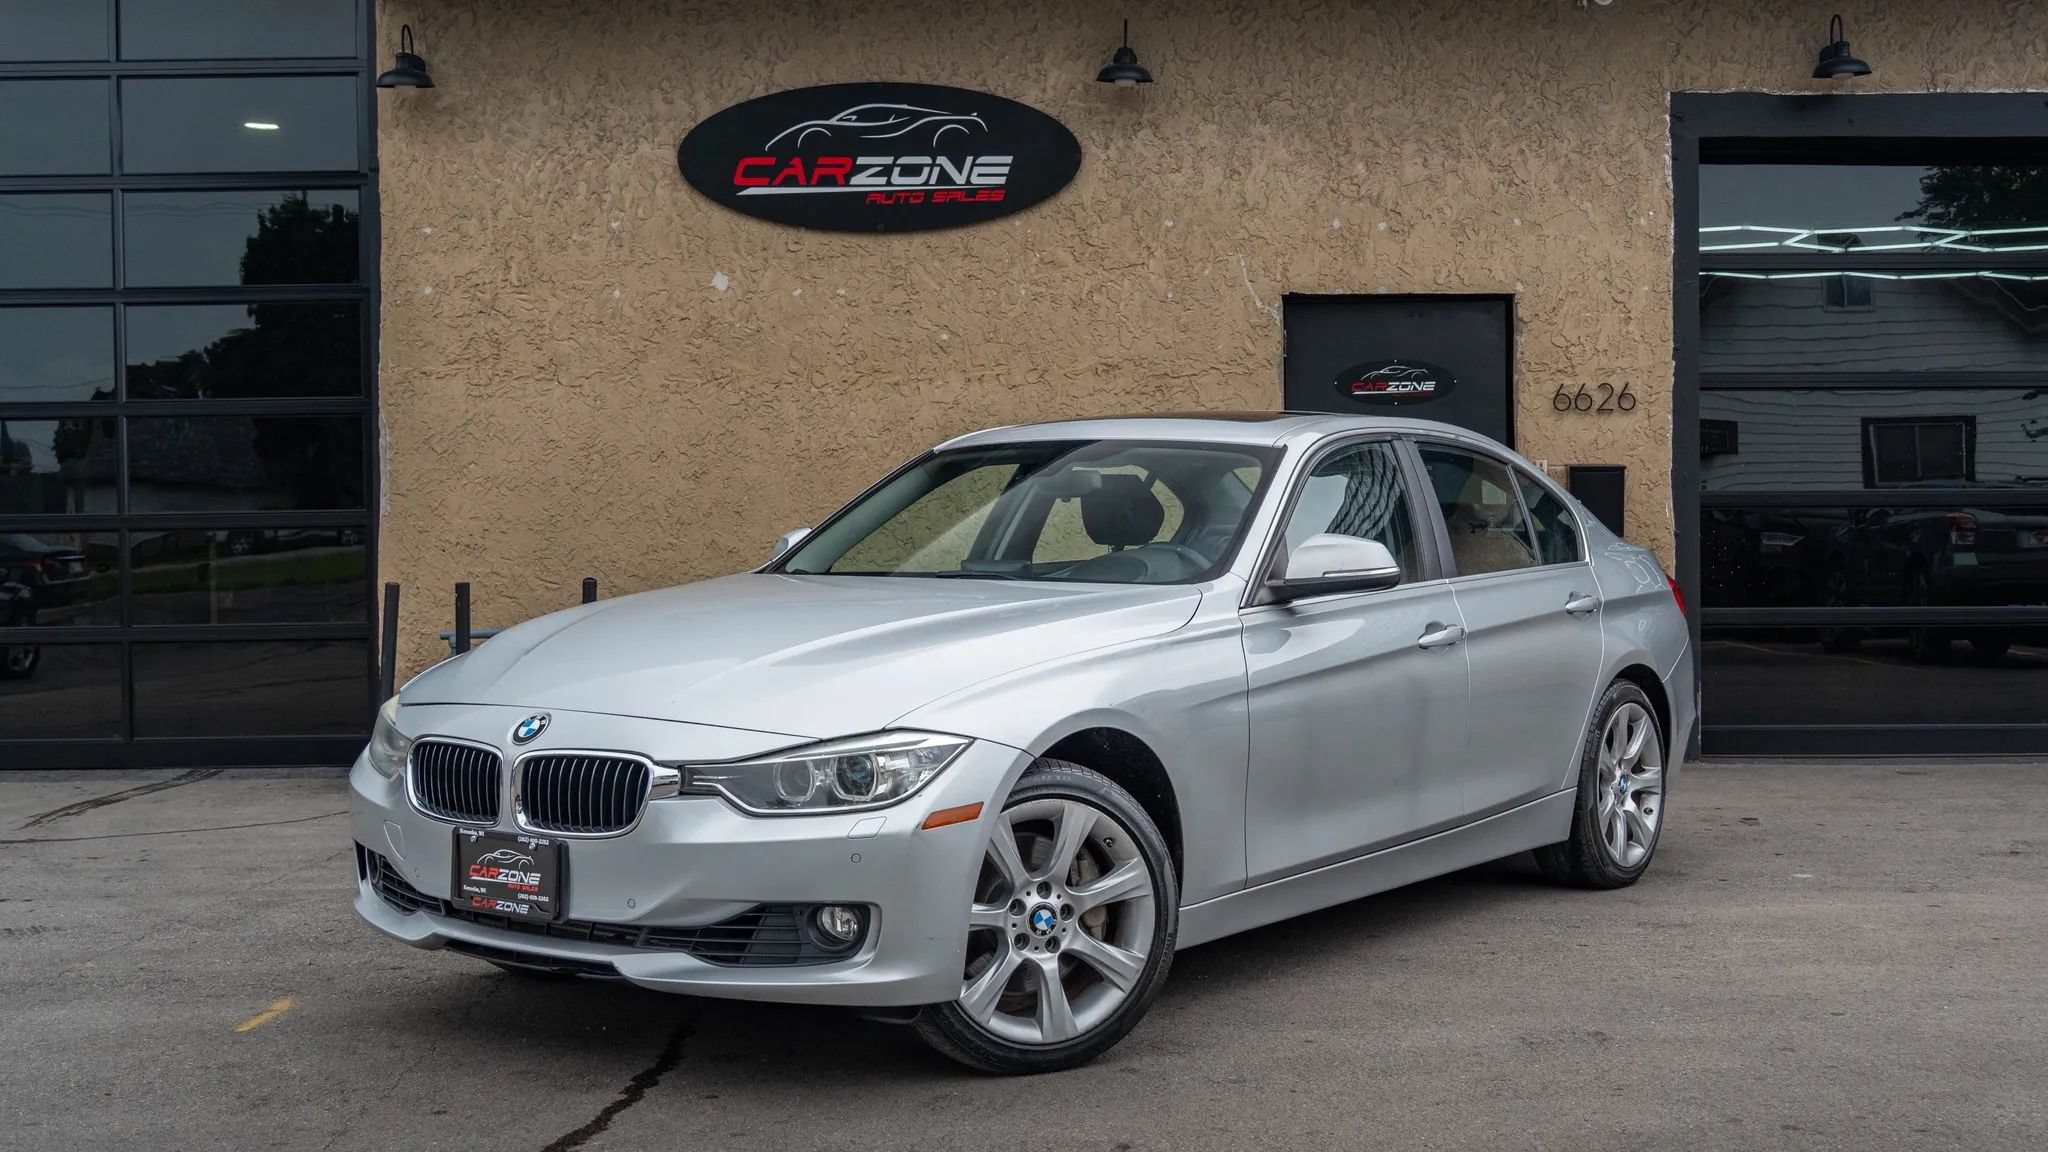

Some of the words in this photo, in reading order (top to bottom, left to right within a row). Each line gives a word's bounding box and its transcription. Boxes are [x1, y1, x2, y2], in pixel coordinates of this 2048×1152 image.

[732, 155, 1014, 186] CARZONE
[865, 191, 925, 205] AUTO
[931, 189, 1007, 202] SALES
[1351, 381, 1437, 392] CARZONE
[1553, 382, 1637, 412] 6626
[469, 864, 541, 885] CARZONE
[471, 896, 530, 914] CARZONE
